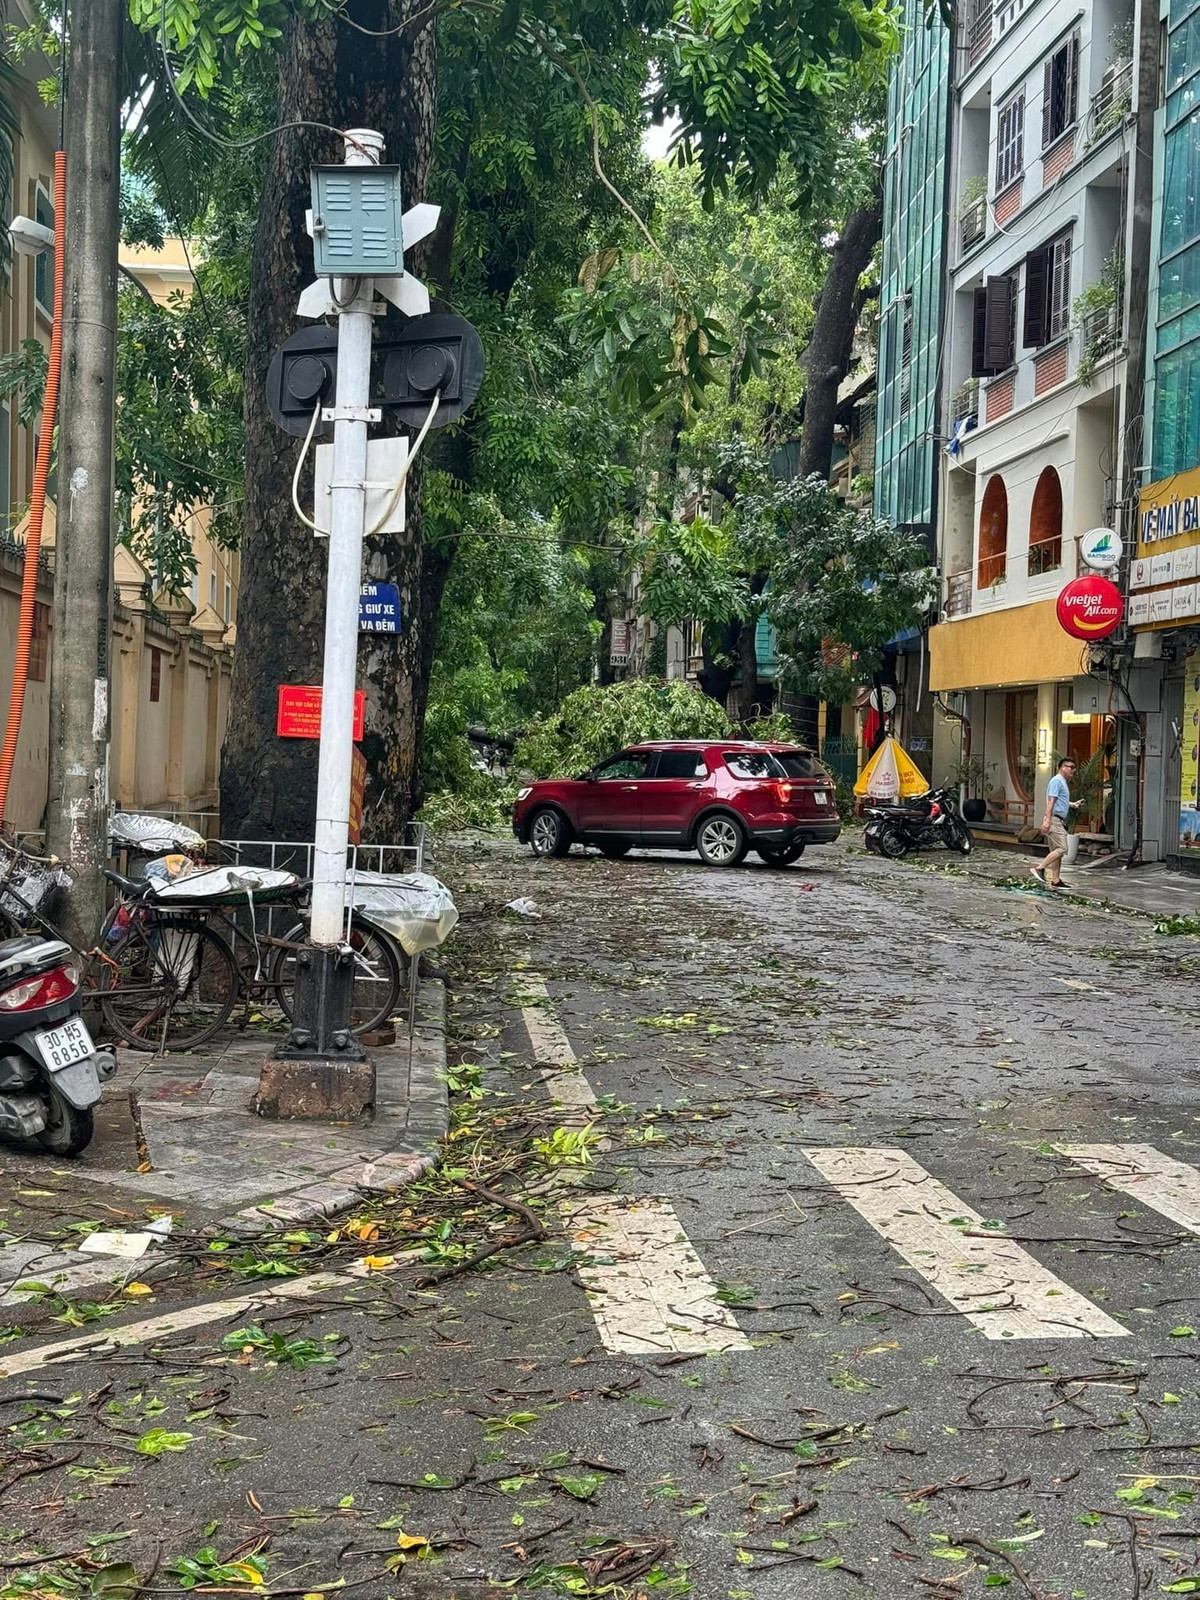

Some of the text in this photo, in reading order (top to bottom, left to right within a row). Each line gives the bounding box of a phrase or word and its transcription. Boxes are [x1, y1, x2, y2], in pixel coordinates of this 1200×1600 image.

[383, 604, 395, 615] XE
[375, 618, 396, 632] ĐÊM
[51, 1040, 89, 1066] 8856
